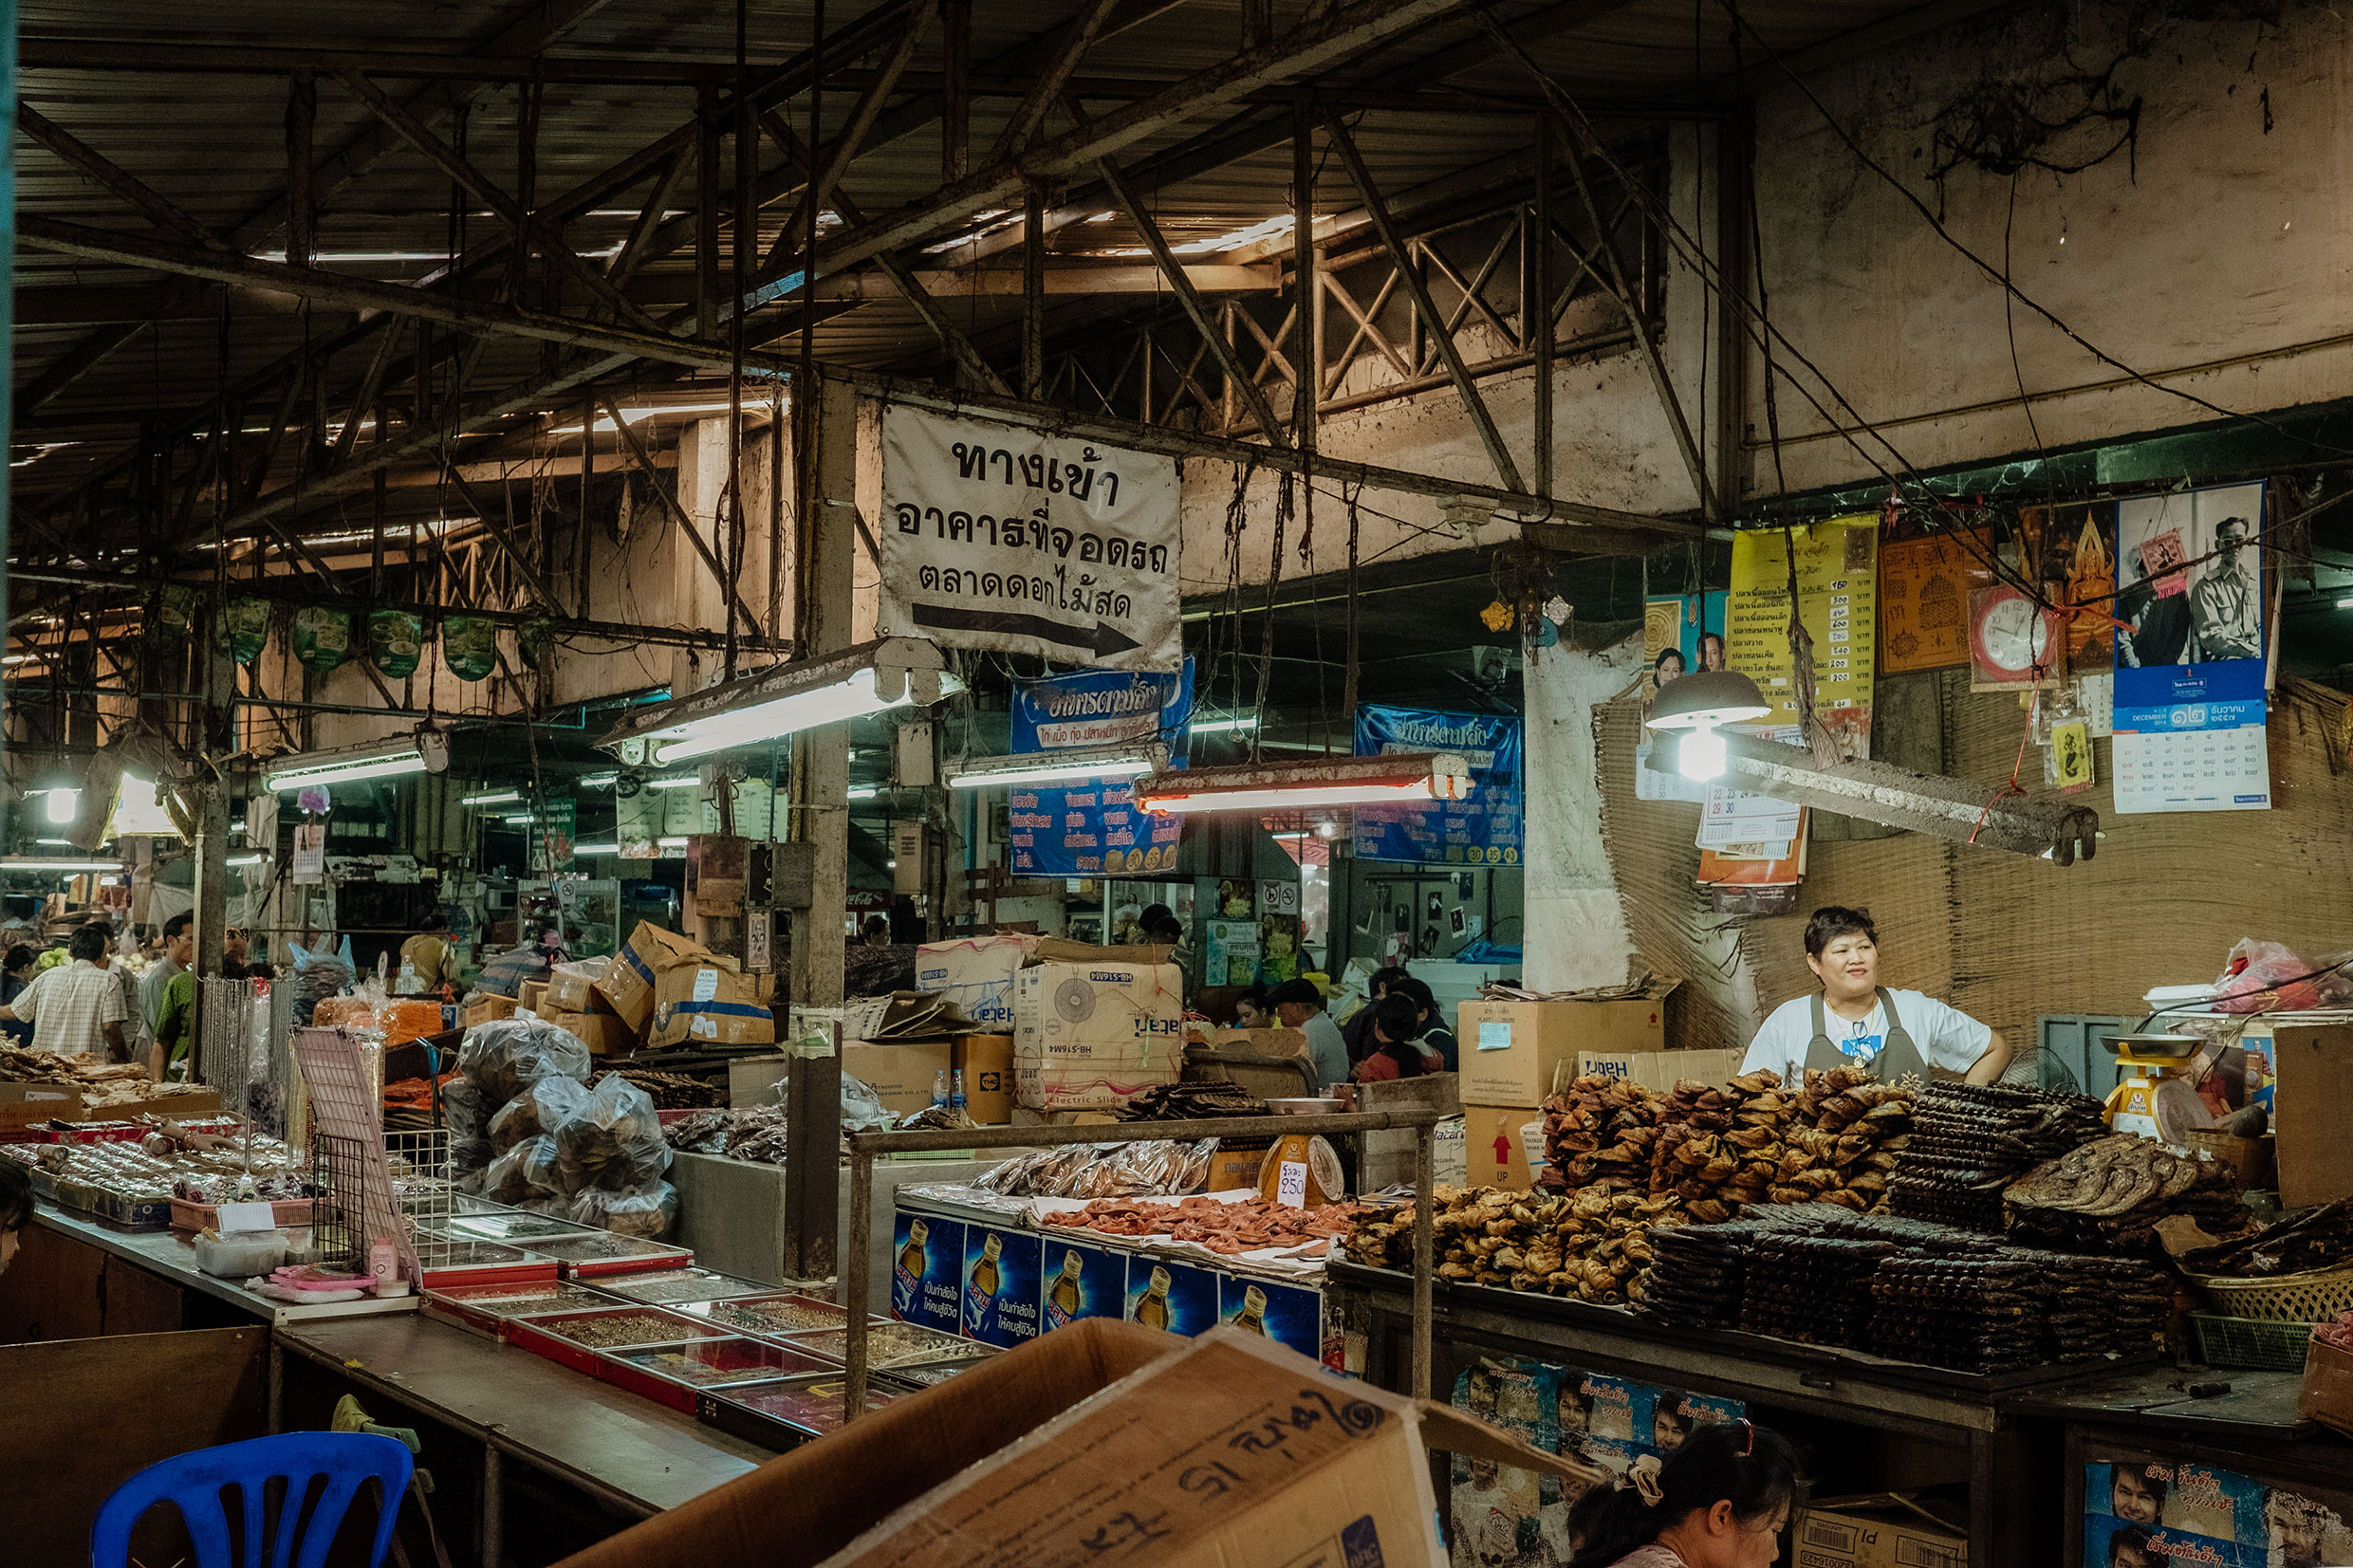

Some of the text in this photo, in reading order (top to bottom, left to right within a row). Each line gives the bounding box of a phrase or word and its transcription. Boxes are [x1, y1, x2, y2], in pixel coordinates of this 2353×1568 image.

[952, 442, 1119, 507] ทางเข้า
[895, 498, 1168, 574] อาคารที่จอดรถ
[918, 563, 1131, 618] ตลาดดอกไม้สด
[2001, 605, 2009, 614] 11
[2013, 601, 2023, 611] 12
[1992, 615, 2001, 624] 10
[1988, 627, 1995, 636] 9
[1732, 649, 1774, 659] ปลาช่อนเค็ม
[1048, 672, 1158, 718] อาหารตามสั่ง
[2211, 706, 2245, 714] ธันวาคม
[1396, 717, 1487, 747] อาหารตามสั่ง
[1714, 789, 1722, 800] 22
[1727, 788, 1735, 800] 23
[1713, 802, 1734, 814] 29 30
[1076, 857, 1100, 870] ราคา
[1129, 854, 1139, 867] 30
[1147, 852, 1158, 865] 35
[1471, 850, 1481, 860] 30
[1489, 850, 1499, 860] 35
[1505, 850, 1515, 860] 40
[1091, 972, 1133, 982] HB-S16M4
[1135, 1019, 1182, 1037] atari
[1496, 1171, 1509, 1182] UP
[1282, 1177, 1304, 1195] 250
[897, 1264, 917, 1290] ฉลาม
[924, 1281, 957, 1301] เป็นกำลังใจ
[969, 1281, 991, 1308] ฉลาม
[923, 1296, 957, 1319] ให้คนสู้ชีวิต
[998, 1298, 1036, 1318] เป็นกำลังใจ
[997, 1315, 1036, 1337] ให้คนสู้ชีวิต
[1178, 1461, 1247, 1509] 15
[2145, 1530, 2224, 1568] เริ่มต้นดีๆ
